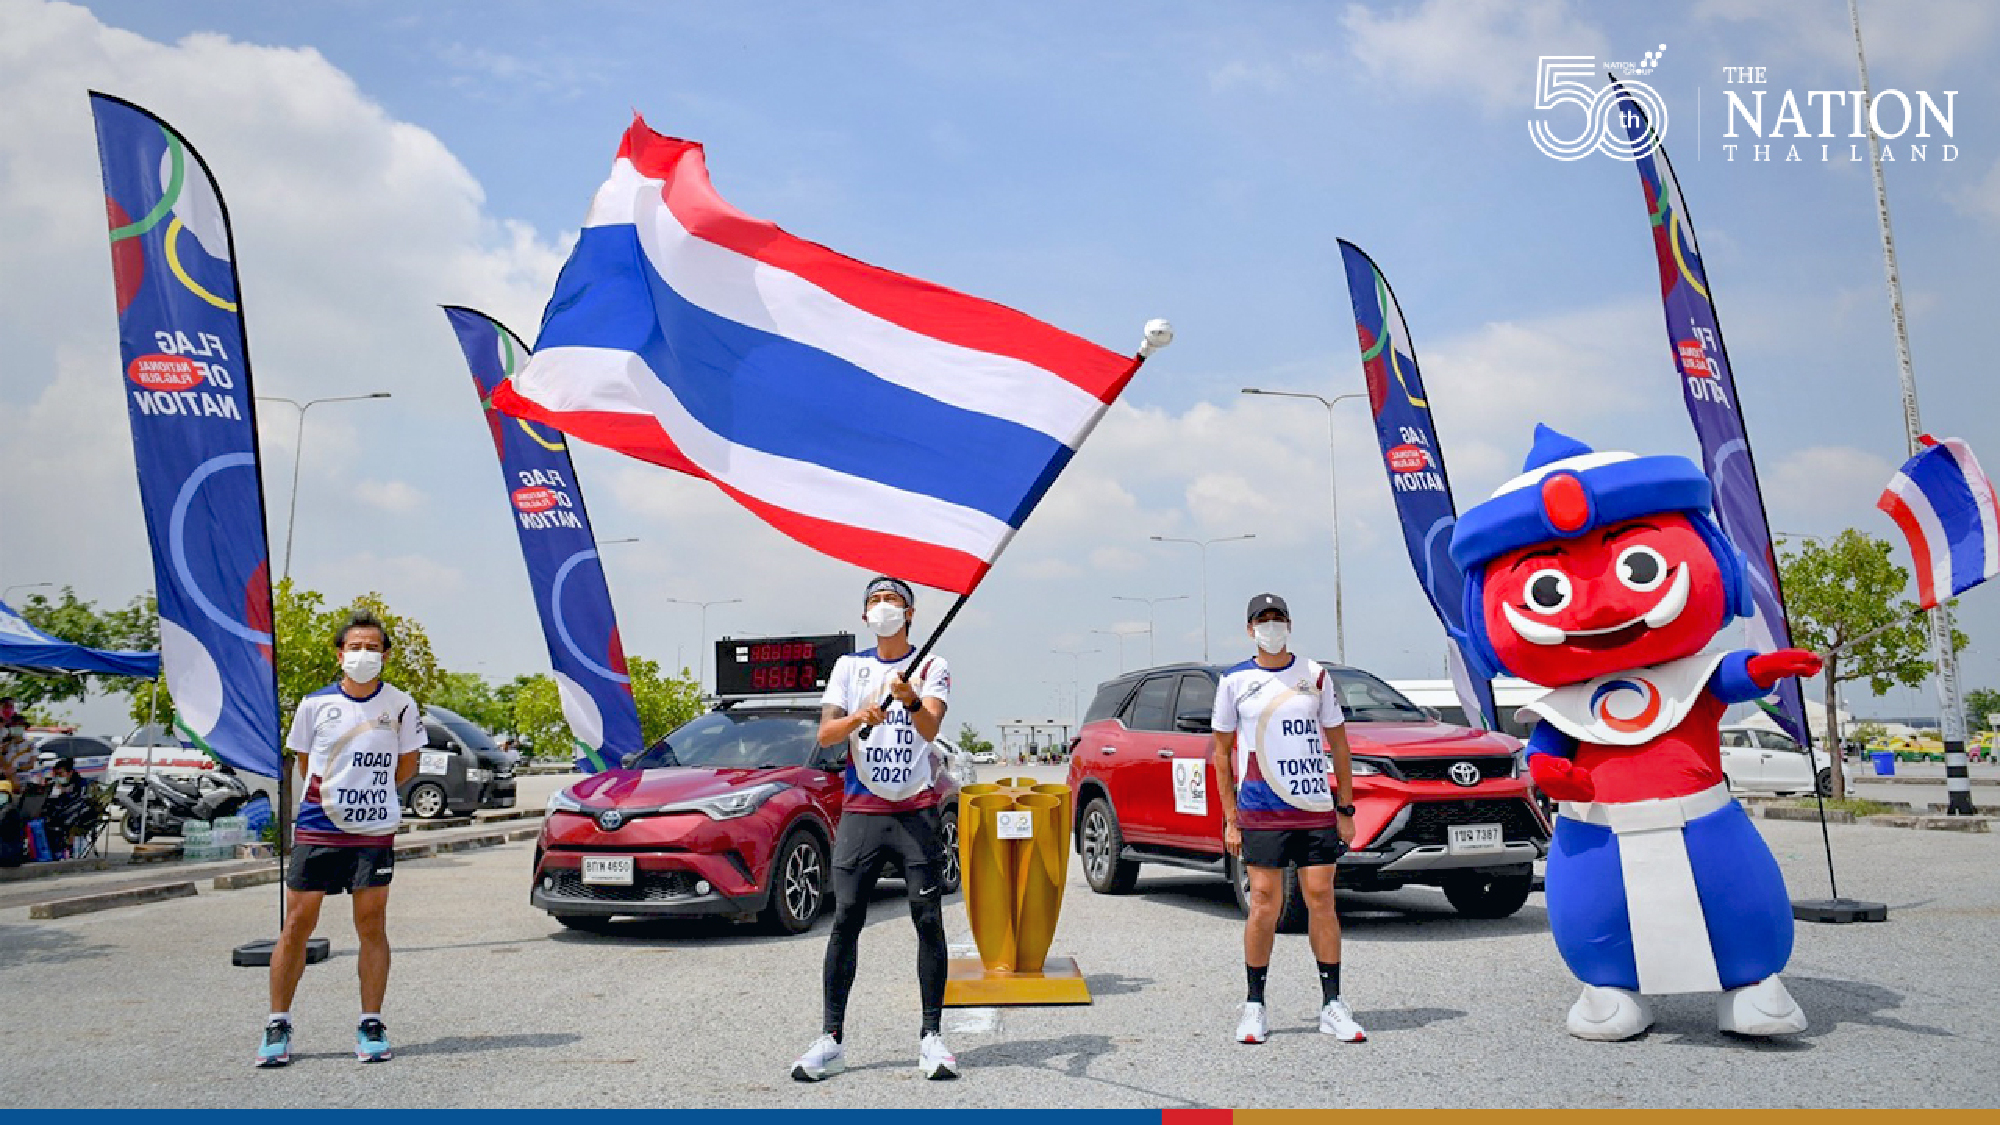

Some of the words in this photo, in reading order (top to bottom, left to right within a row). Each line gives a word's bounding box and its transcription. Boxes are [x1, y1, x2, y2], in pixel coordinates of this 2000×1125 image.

[883, 710, 913, 726] OAD
[894, 729, 914, 745] TO
[352, 751, 392, 768] ROAD
[865, 746, 914, 763] TOKYO
[871, 766, 912, 783] 2020
[1277, 758, 1324, 778] TOKYO
[372, 769, 389, 786] TO
[337, 788, 388, 806] TOKYO
[343, 806, 388, 823] 2020
